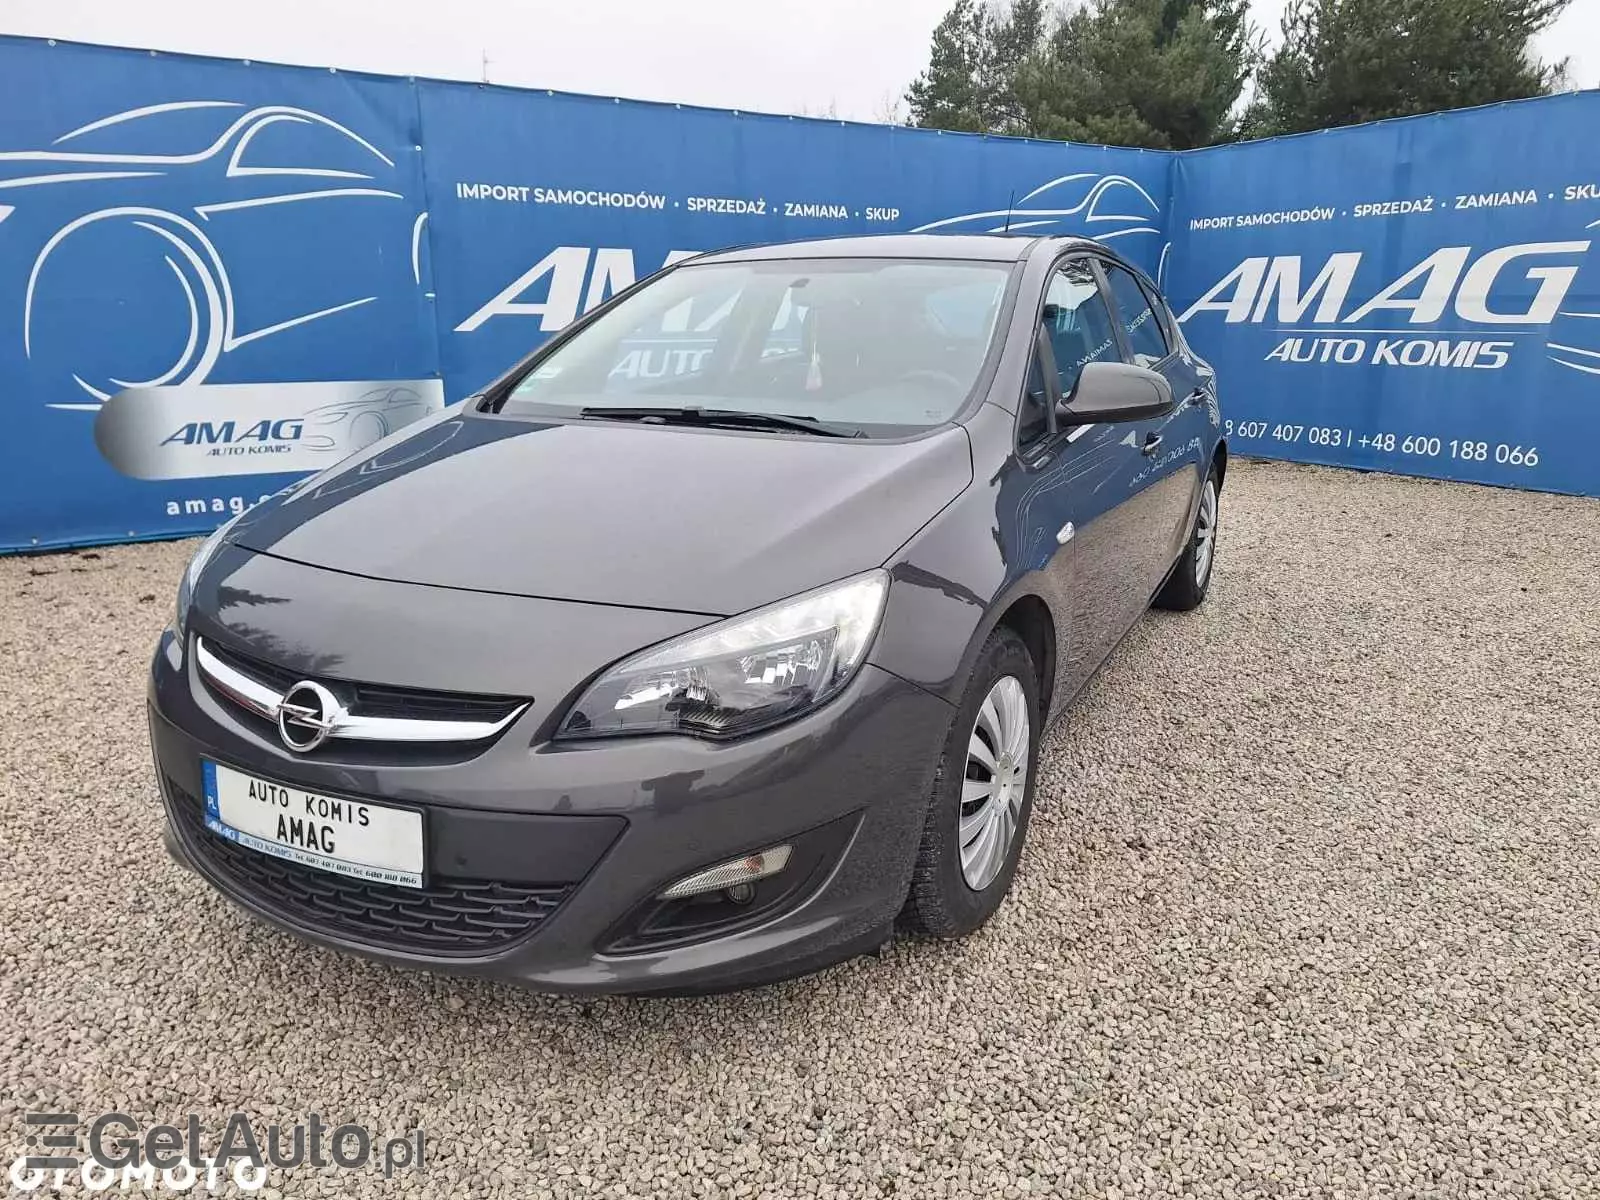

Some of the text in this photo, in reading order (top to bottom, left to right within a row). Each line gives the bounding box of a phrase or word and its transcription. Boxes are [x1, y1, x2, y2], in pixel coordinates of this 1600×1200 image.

[456, 183, 900, 221] IMPORT SAMOCHODÓW SPRZEDAŻ ZAMIANA SKUP
[1190, 217, 1235, 230] IMPORT
[1236, 206, 1336, 227] SAMOCHODÓW
[1353, 196, 1434, 218] SPRZEDAŻ
[1454, 189, 1538, 210] ZAMIANA
[1264, 338, 1514, 369] AUTO KOMIS
[207, 443, 291, 457] AUTO KOMIS
[1238, 421, 1269, 439] 607
[1272, 424, 1305, 442] 407
[1308, 427, 1342, 447] 083
[1358, 433, 1396, 452] +48
[1401, 435, 1441, 457] 600
[1449, 440, 1488, 461] 188
[1495, 444, 1539, 467] 066
[207, 795, 217, 810] PL
[248, 780, 370, 827] AUTO KOMIS
[277, 814, 336, 854] AMAG
